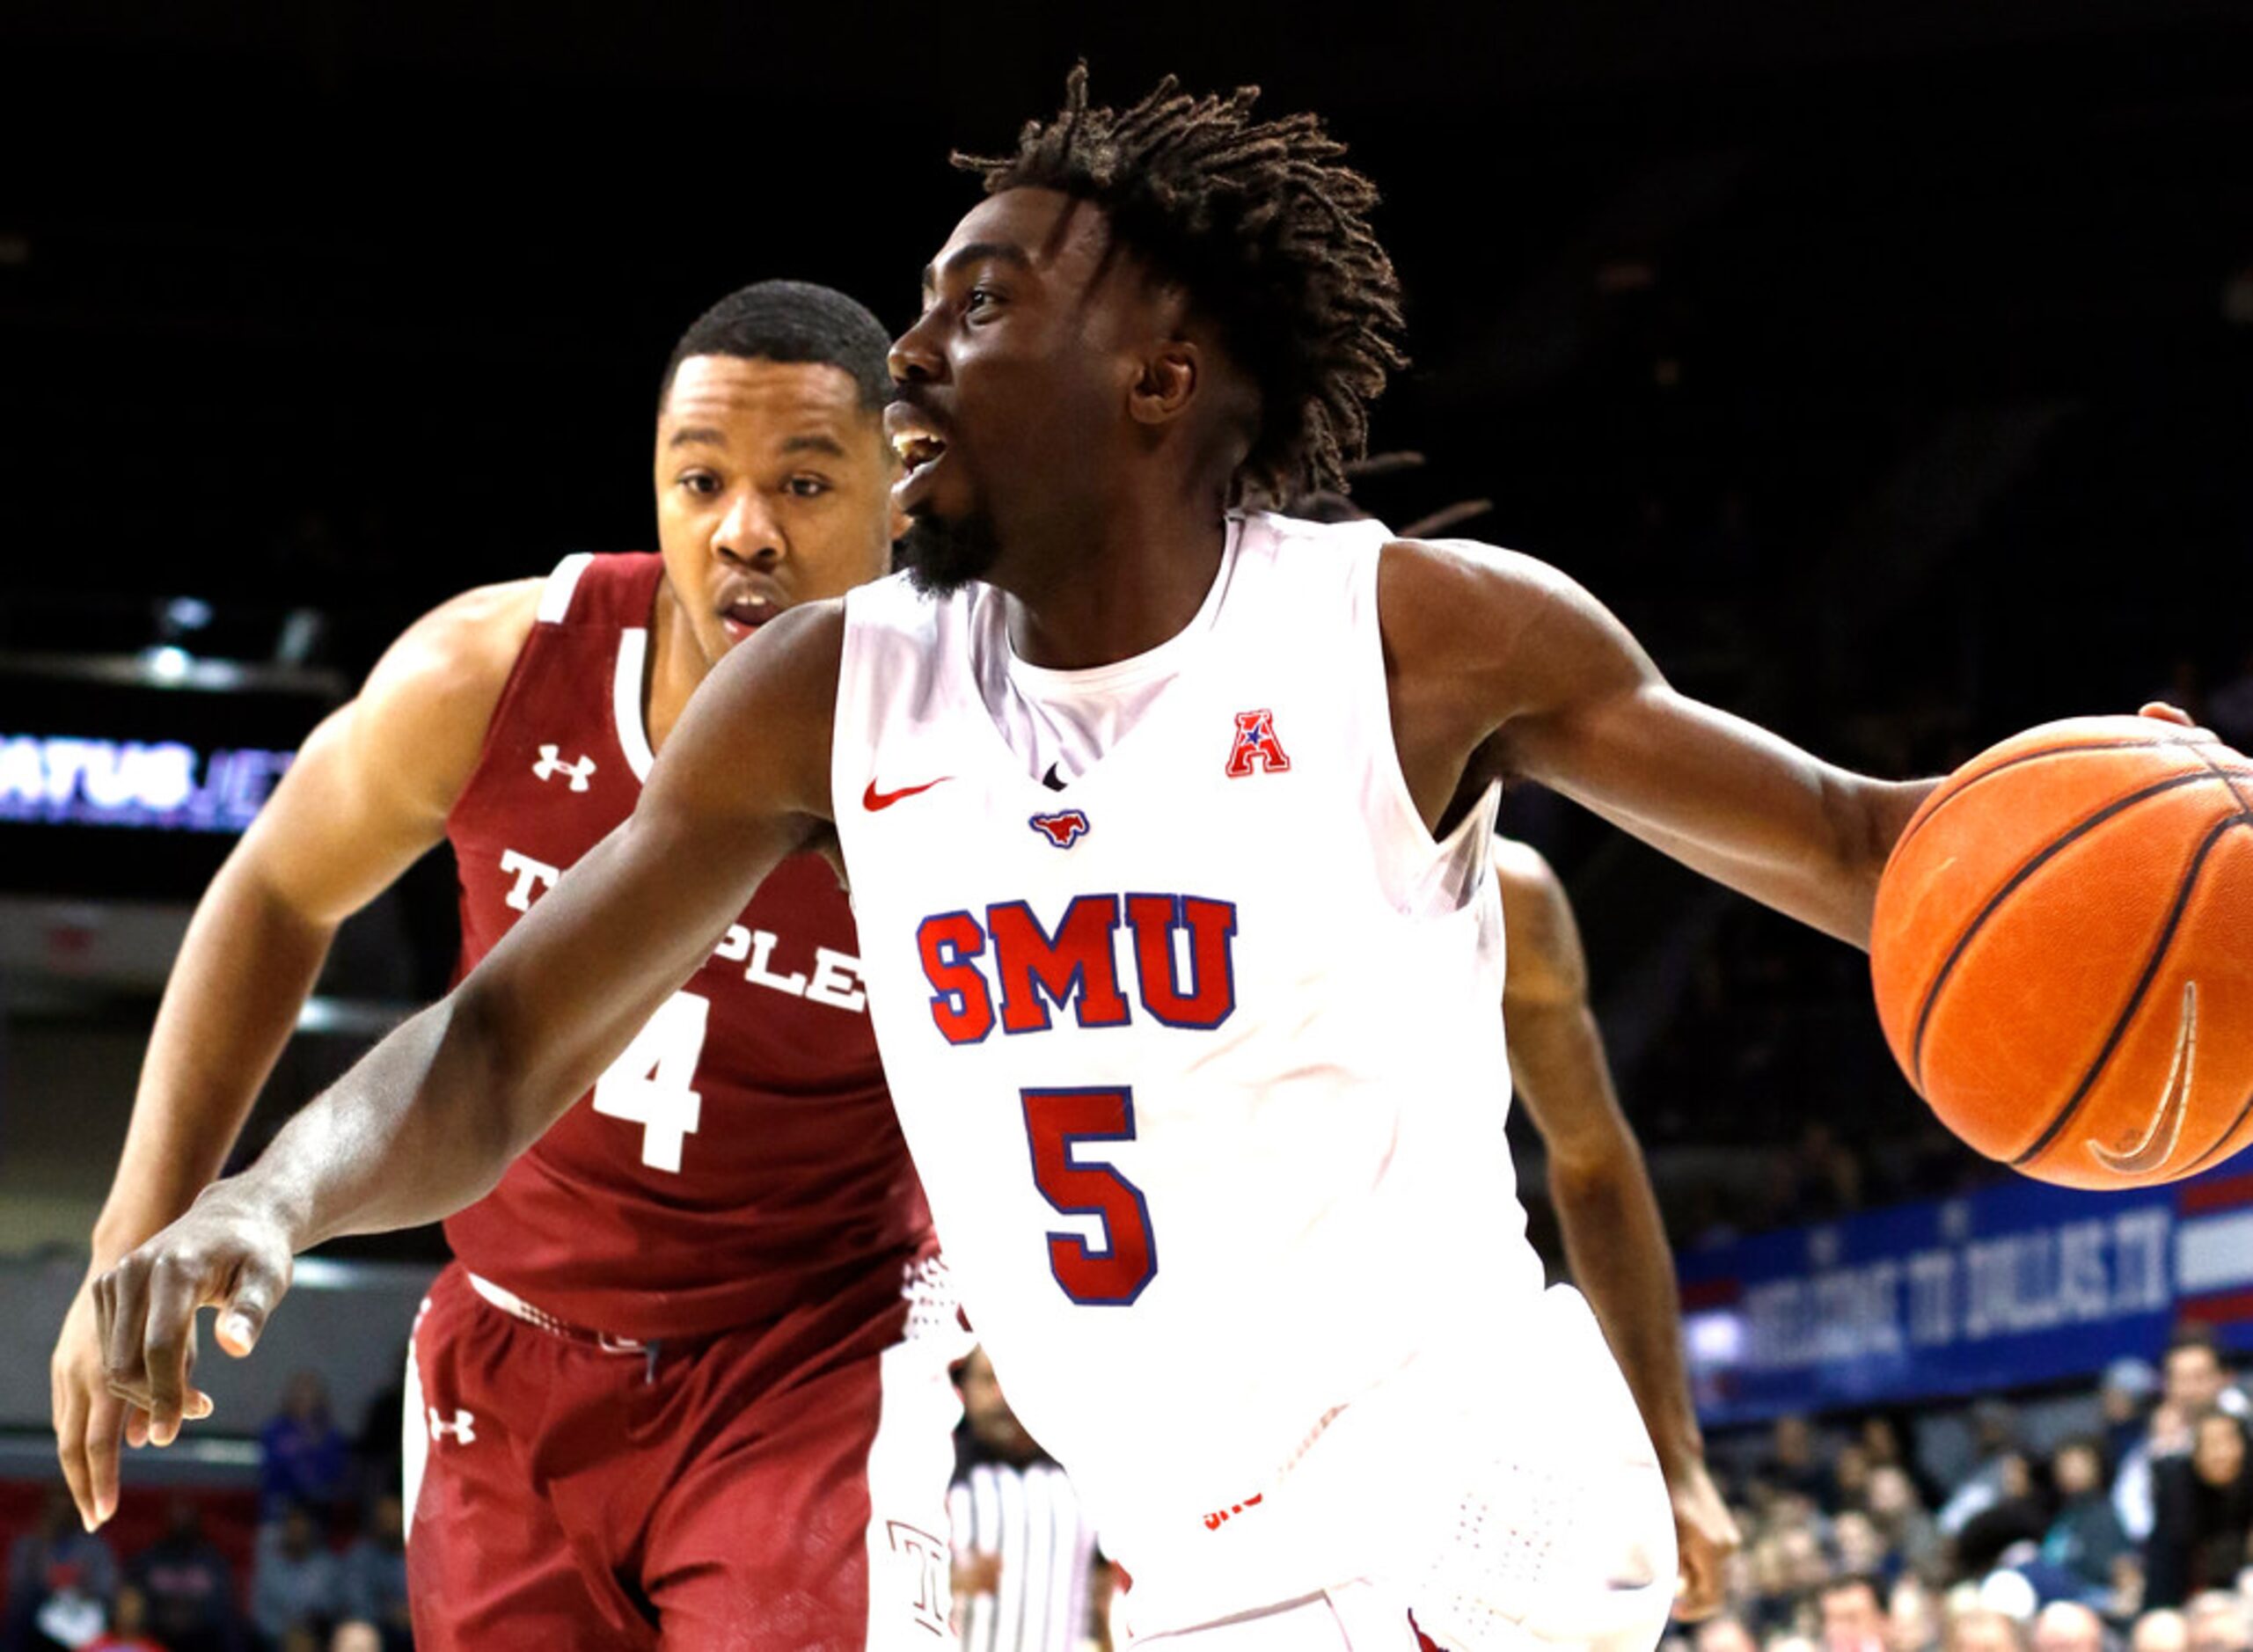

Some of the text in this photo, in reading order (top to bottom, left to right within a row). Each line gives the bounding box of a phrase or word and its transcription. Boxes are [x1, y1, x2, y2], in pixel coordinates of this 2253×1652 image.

[916, 892, 1238, 1046] SMU
[591, 989, 710, 1174] 4
[1019, 1085, 1159, 1306] 5
